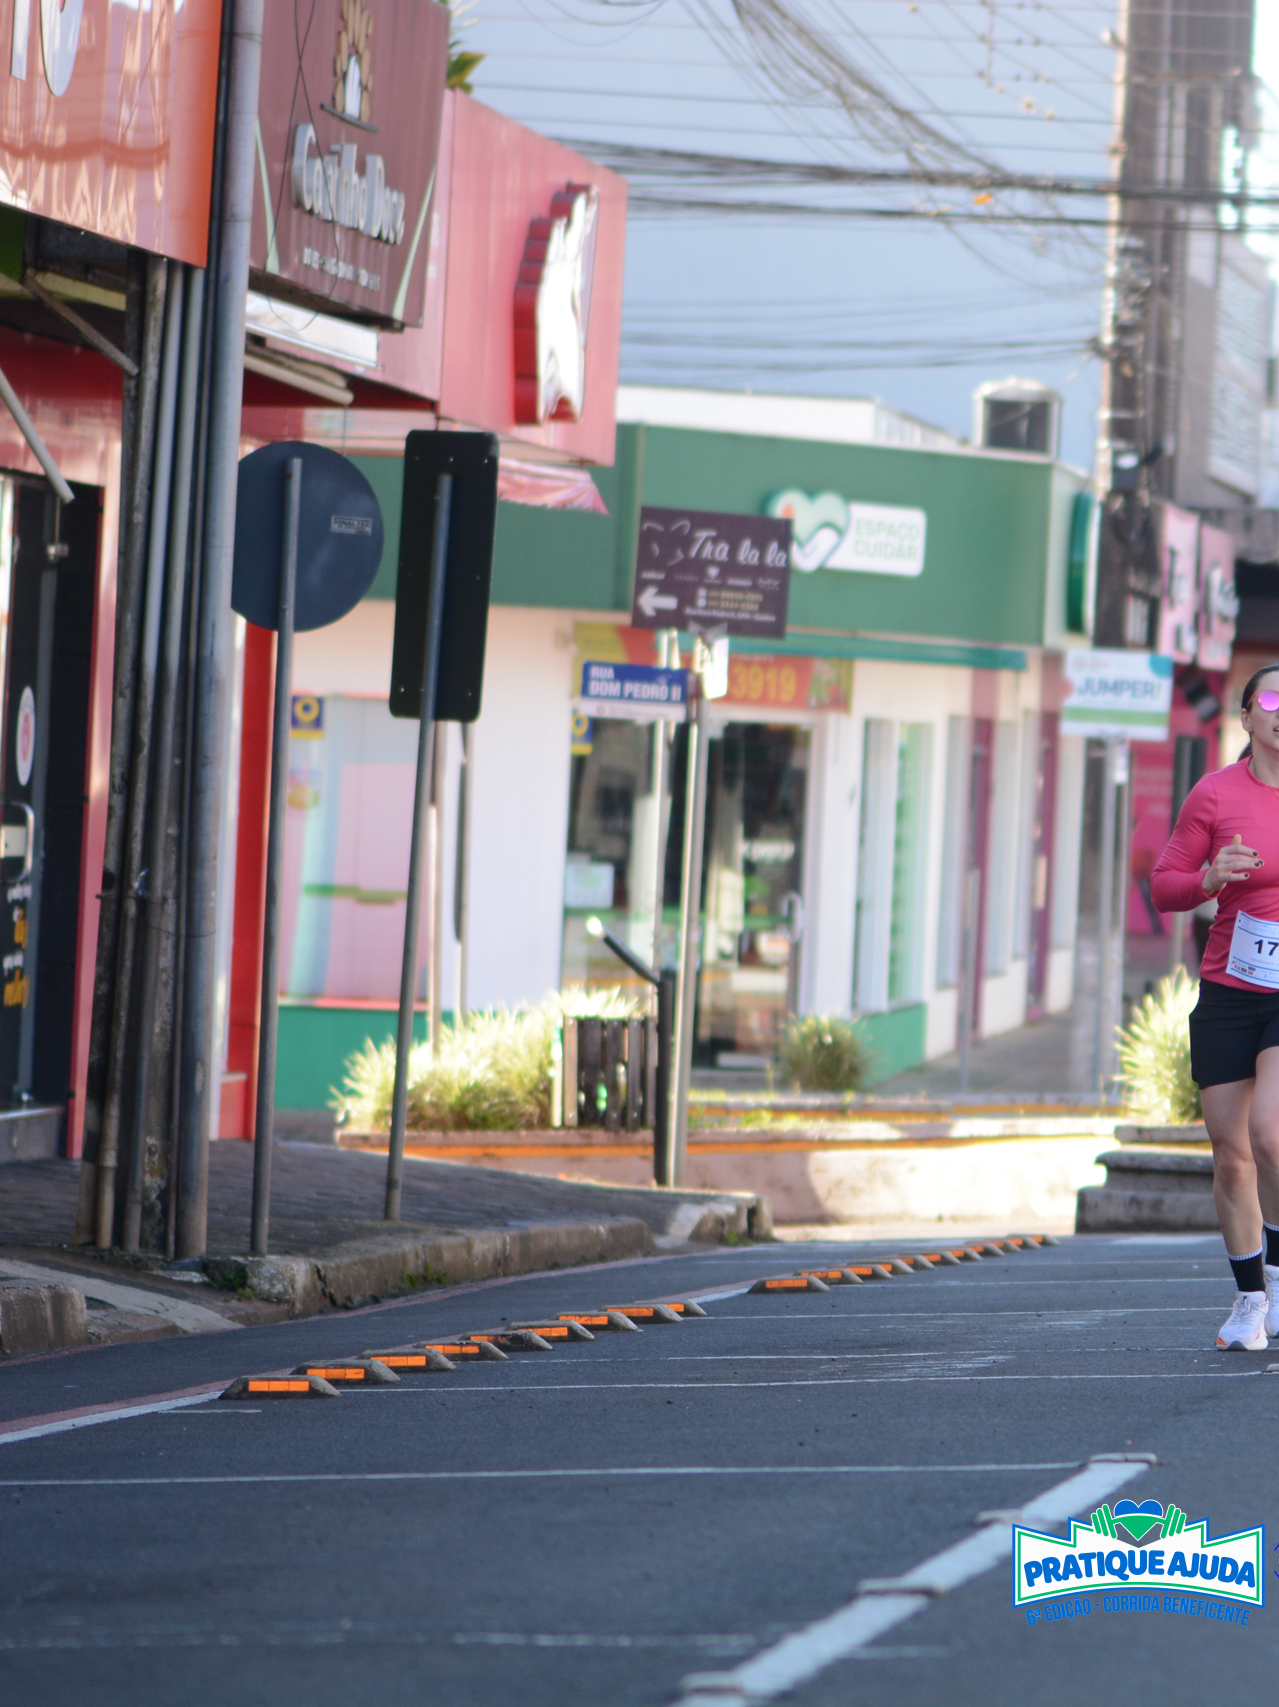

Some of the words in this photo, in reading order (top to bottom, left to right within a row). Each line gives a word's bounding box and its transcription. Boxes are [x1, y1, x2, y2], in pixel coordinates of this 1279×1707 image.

[690, 530, 730, 562] Tra
[738, 537, 760, 565] la
[766, 541, 787, 567] la
[854, 539, 919, 561] CUIDAR
[590, 666, 615, 680] RUA
[589, 680, 620, 698] DOM
[623, 681, 668, 700] PEDRO
[671, 685, 682, 701] II
[1077, 677, 1162, 700] JUMPER!
